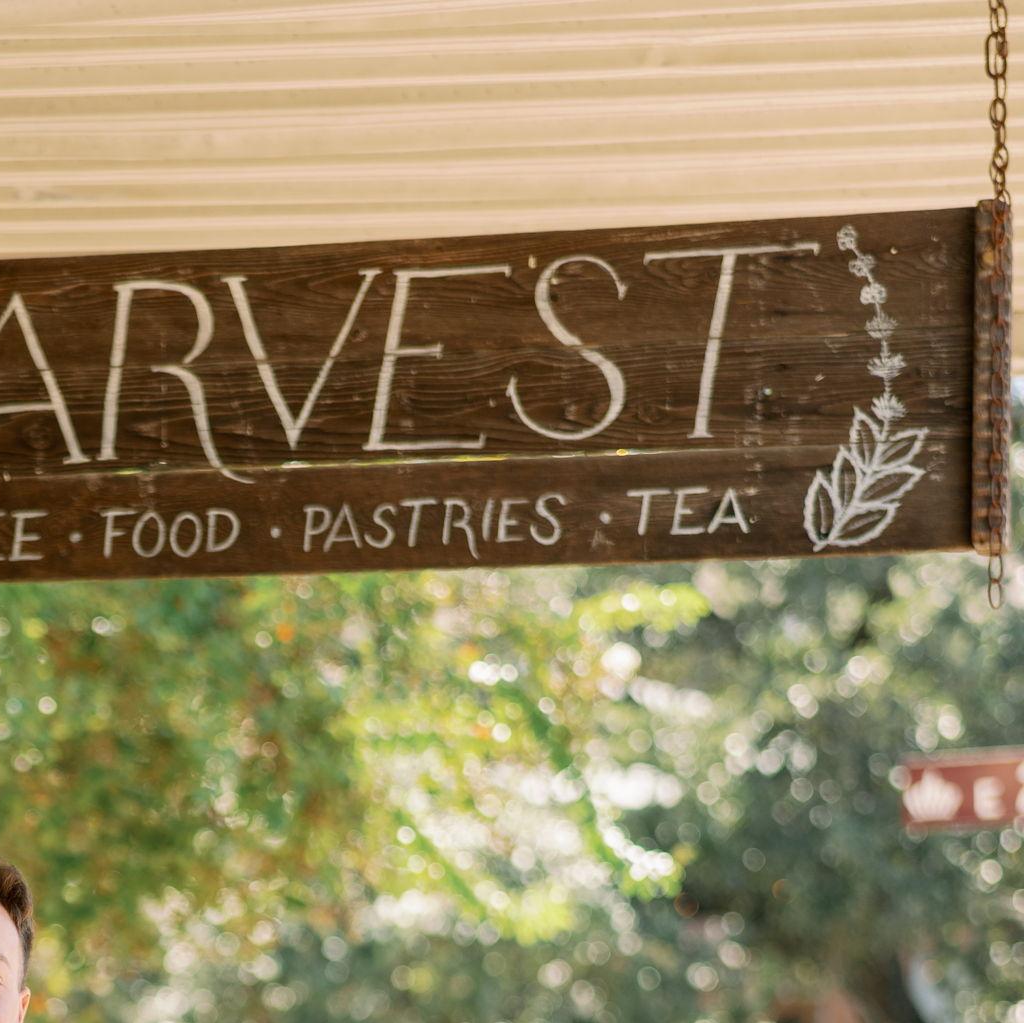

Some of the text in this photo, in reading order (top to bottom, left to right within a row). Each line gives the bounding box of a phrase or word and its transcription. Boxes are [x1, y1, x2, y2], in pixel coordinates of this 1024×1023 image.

[101, 508, 241, 559] FOOD
[303, 495, 566, 558] PASTRIES
[628, 488, 749, 535] TEA
